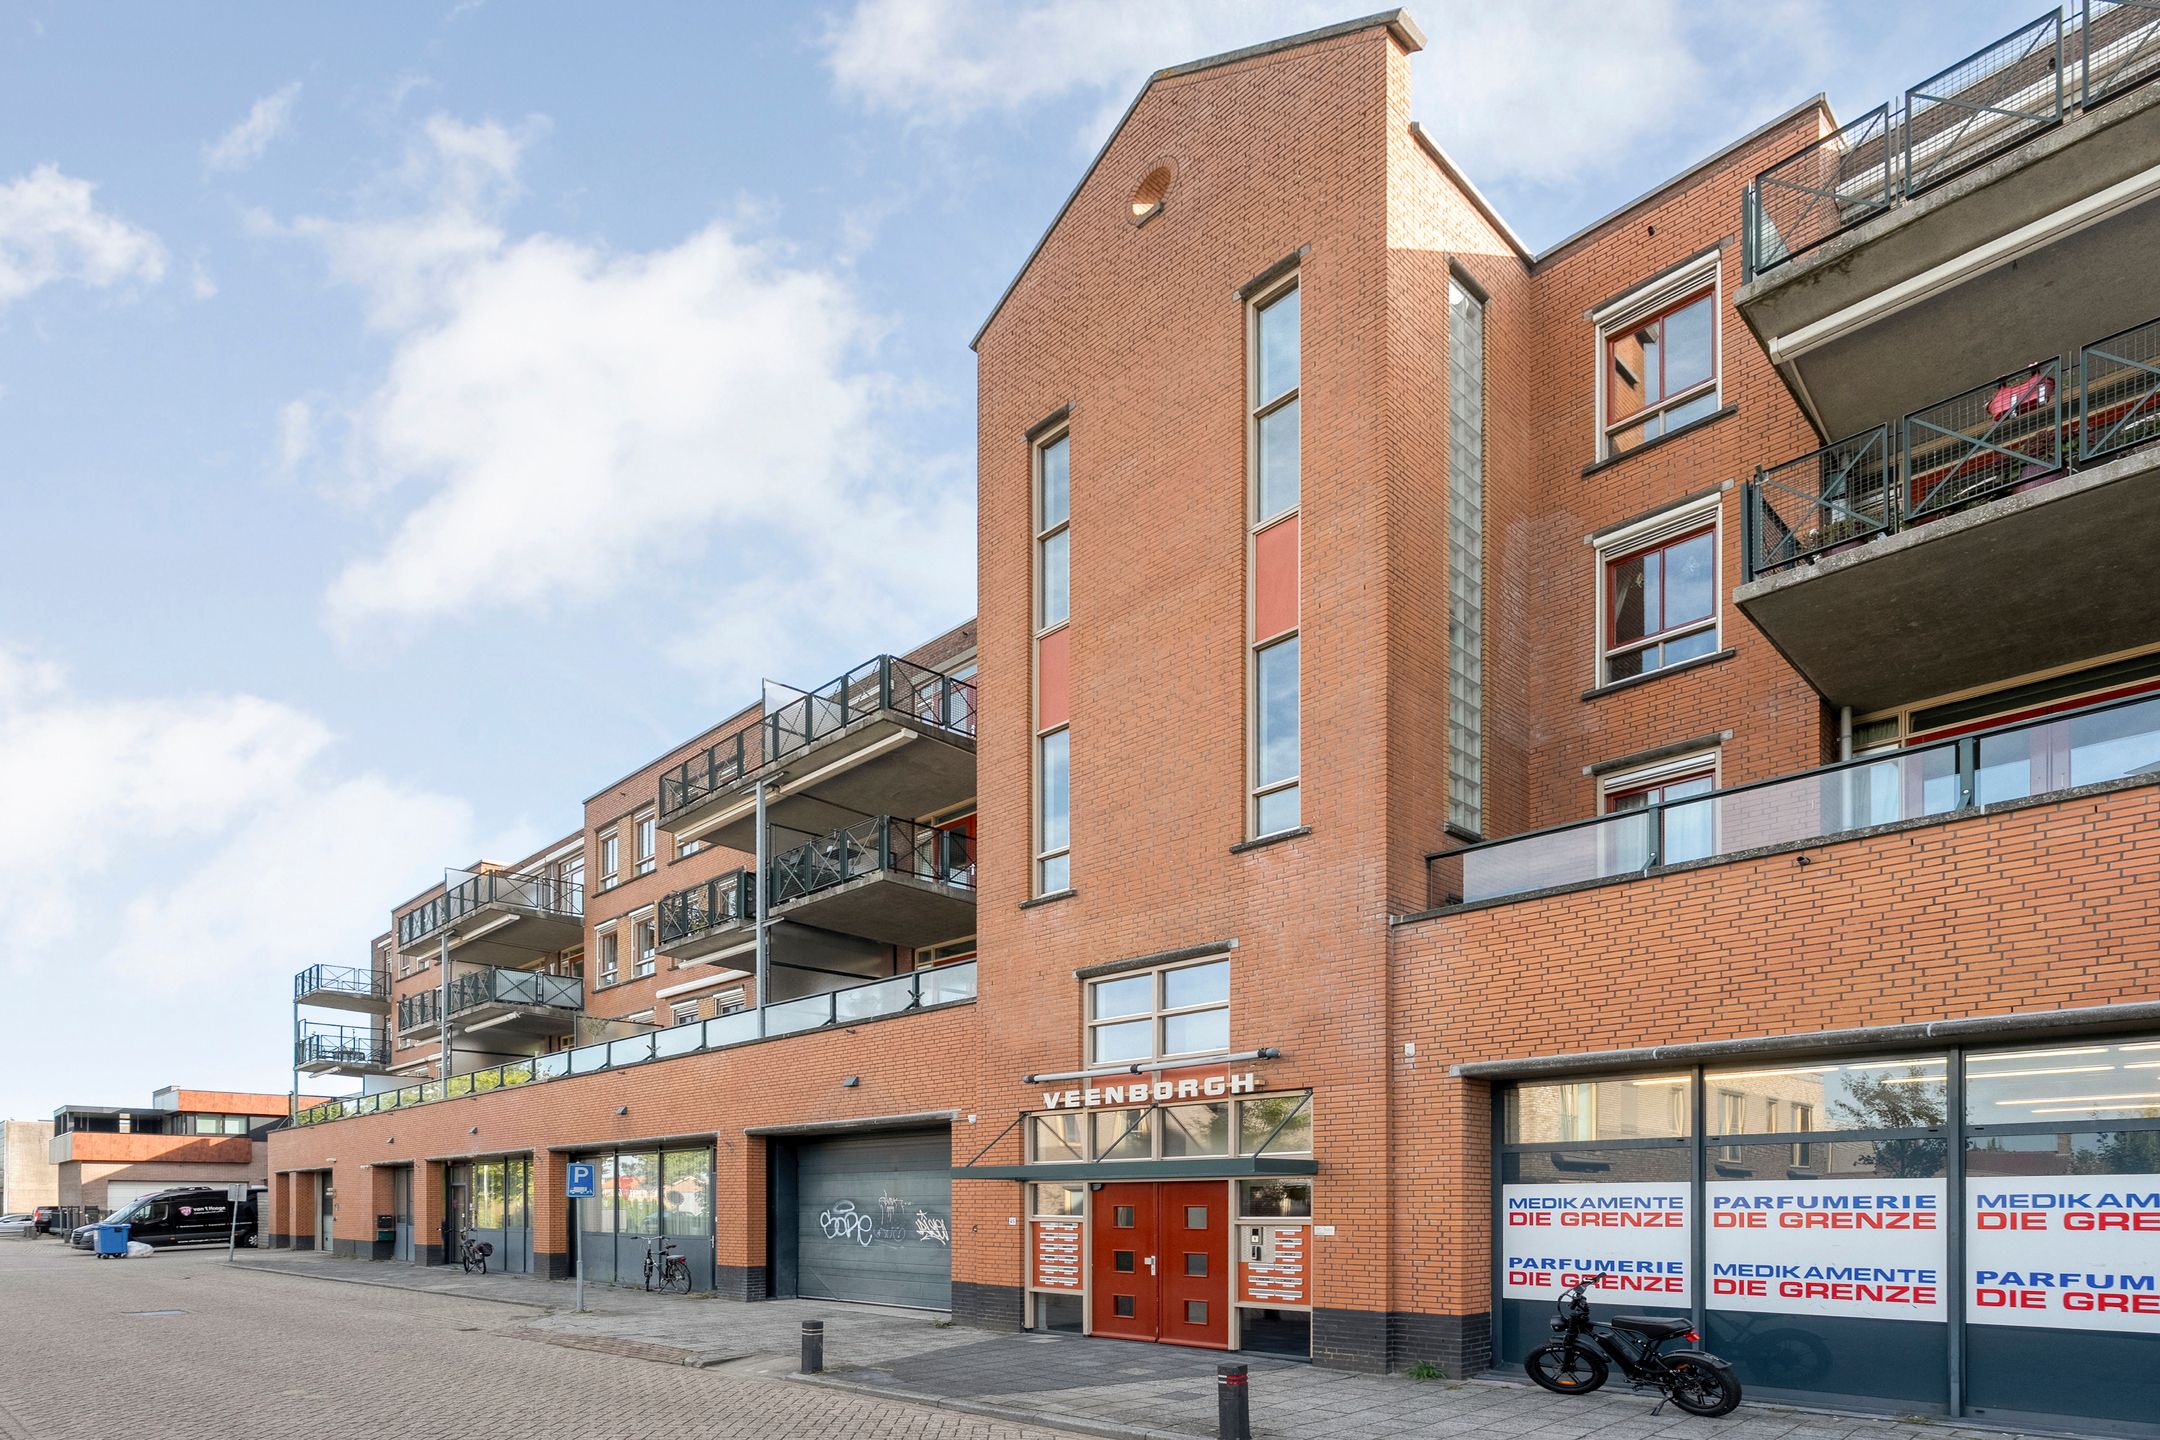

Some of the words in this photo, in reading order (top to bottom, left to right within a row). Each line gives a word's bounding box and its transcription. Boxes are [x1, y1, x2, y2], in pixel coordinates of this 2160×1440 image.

[1043, 1073, 1254, 1109] VEENBORGH
[574, 1166, 589, 1184] P
[1509, 1197, 1683, 1209] MEDIKAMENTE
[1713, 1195, 1937, 1210] PARFUMERIE
[1509, 1212, 1551, 1227] DIE
[1560, 1212, 1683, 1228] GRENZE
[1713, 1212, 1767, 1229] DIE
[1779, 1212, 1937, 1230] GRENZE
[1977, 1212, 2047, 1231] DIE
[2063, 1212, 2160, 1231] GRE
[1509, 1257, 1683, 1274] PARFUMERIE
[1713, 1263, 1937, 1284] MEDIKAMENTE
[1509, 1271, 1551, 1287] DIE
[1976, 1270, 2155, 1291] PARFUM
[1713, 1279, 1767, 1297] DIE
[1779, 1281, 1937, 1305] GRENZE
[1976, 1289, 2047, 1309] DIE
[2063, 1292, 2160, 1314] GRE
